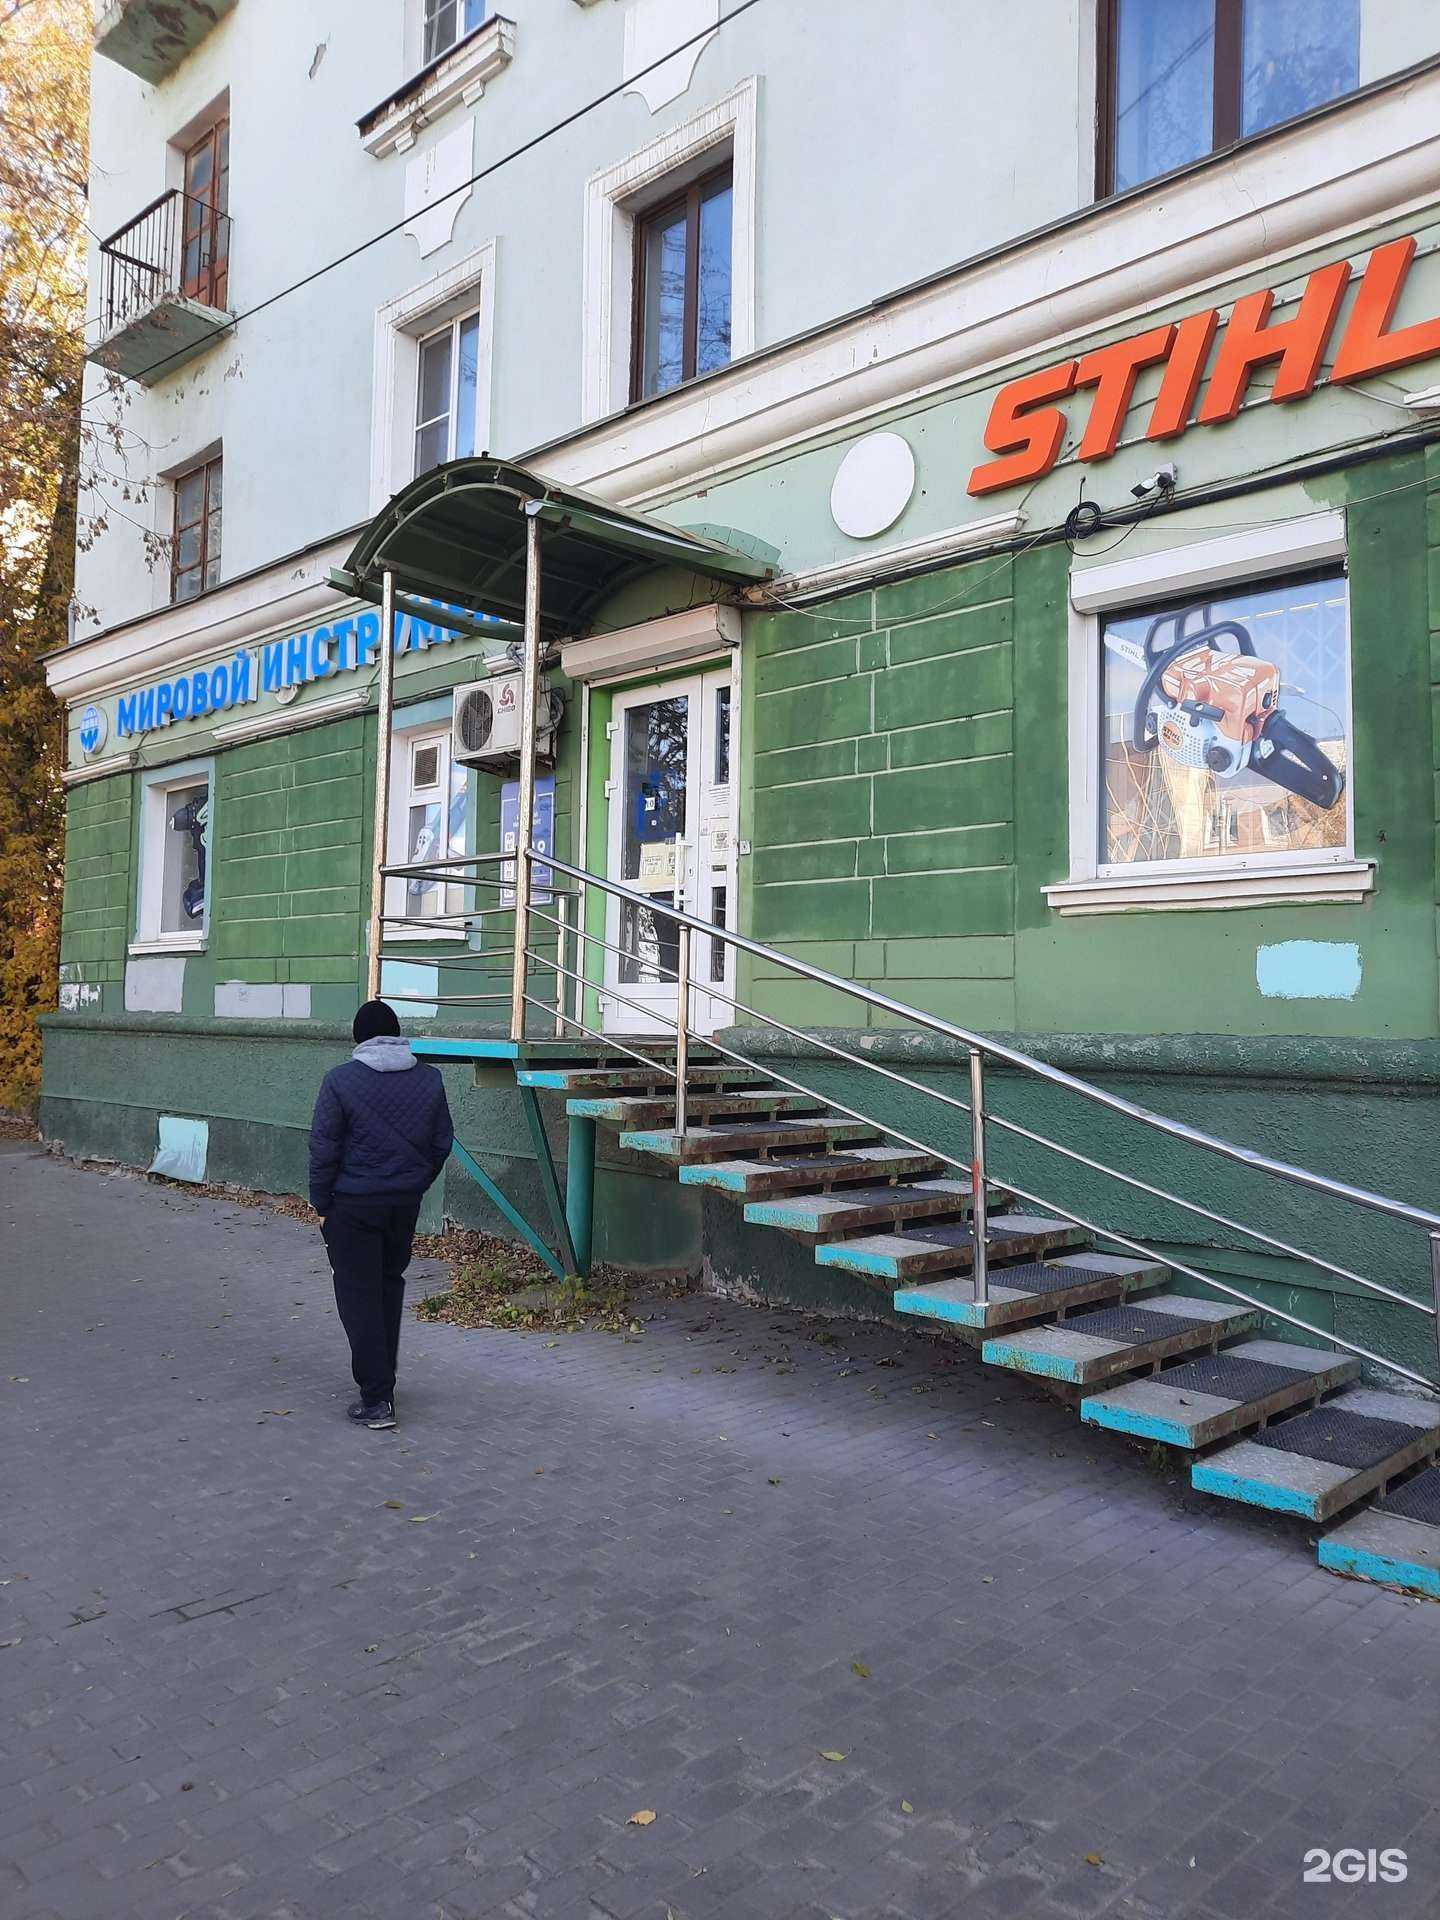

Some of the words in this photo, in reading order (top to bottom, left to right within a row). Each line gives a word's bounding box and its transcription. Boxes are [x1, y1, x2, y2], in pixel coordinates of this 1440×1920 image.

[966, 235, 1440, 496] STIHL
[117, 649, 256, 737] МИРОВОЙ
[263, 597, 500, 693] ИНСТРУМ
[1120, 643, 1140, 660] STIHL
